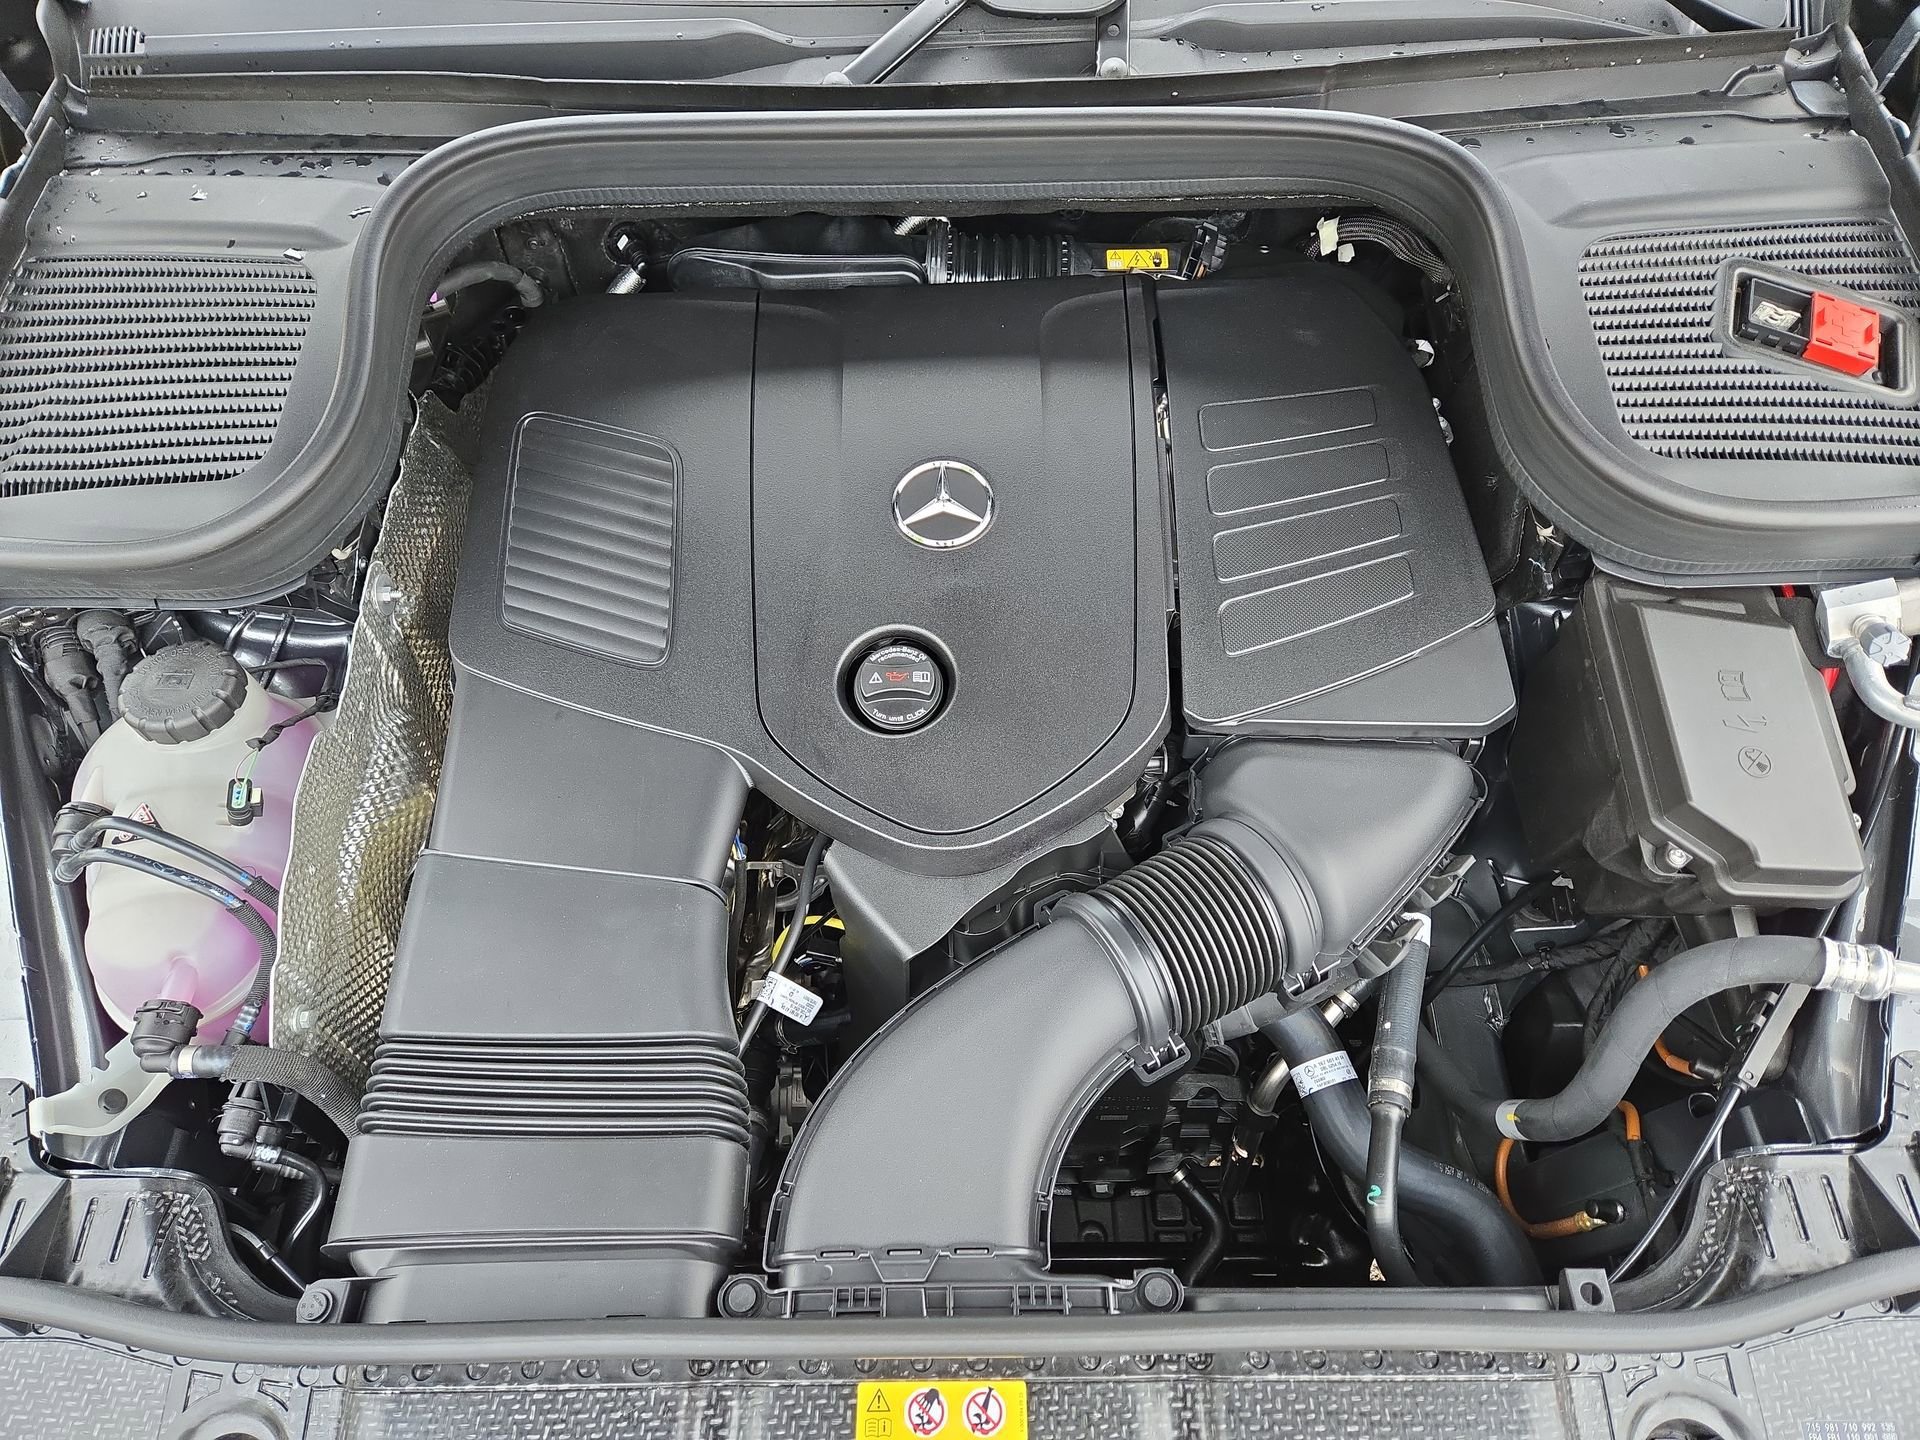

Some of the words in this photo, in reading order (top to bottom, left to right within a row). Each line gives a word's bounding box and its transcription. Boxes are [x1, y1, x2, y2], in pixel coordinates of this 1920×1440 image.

[878, 652, 921, 663] recommended
[872, 708, 887, 720] Turn
[906, 707, 927, 720] CLICK
[1806, 1422, 1821, 1432] 715
[1824, 1422, 1839, 1432] 981
[1842, 1422, 1858, 1432] 710
[1861, 1422, 1877, 1432] 992
